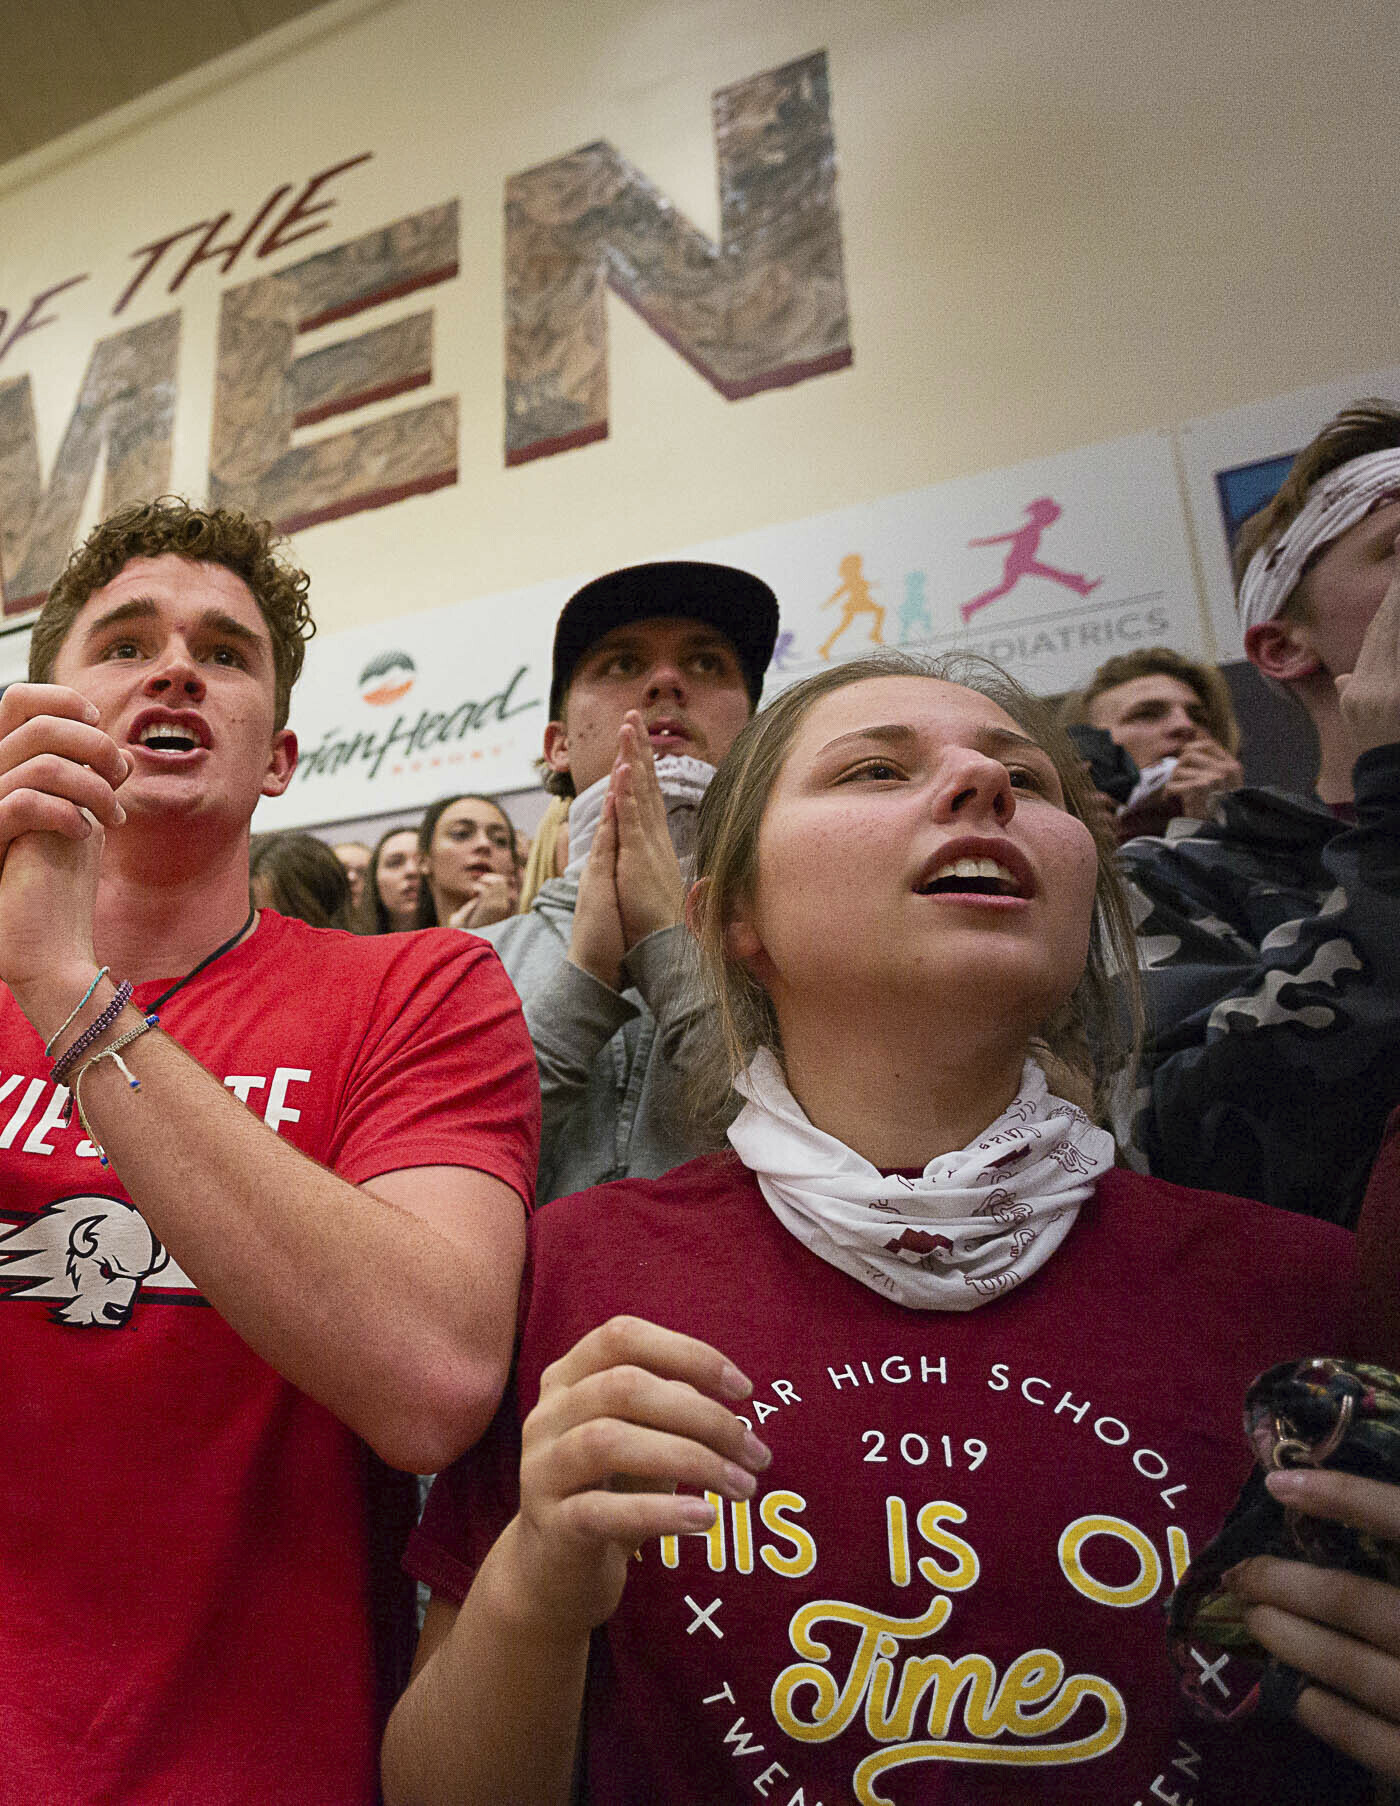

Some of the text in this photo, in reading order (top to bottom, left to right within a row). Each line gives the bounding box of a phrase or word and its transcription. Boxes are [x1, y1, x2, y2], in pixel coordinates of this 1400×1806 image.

[112, 151, 374, 316] THE
[826, 1355, 947, 1390] HIGH
[987, 1363, 1188, 1510] SCHOOL
[860, 1430, 988, 1472] 2019
[634, 1489, 818, 1578] HIS
[886, 1495, 980, 1592] IS
[771, 1595, 1127, 1806] Time
